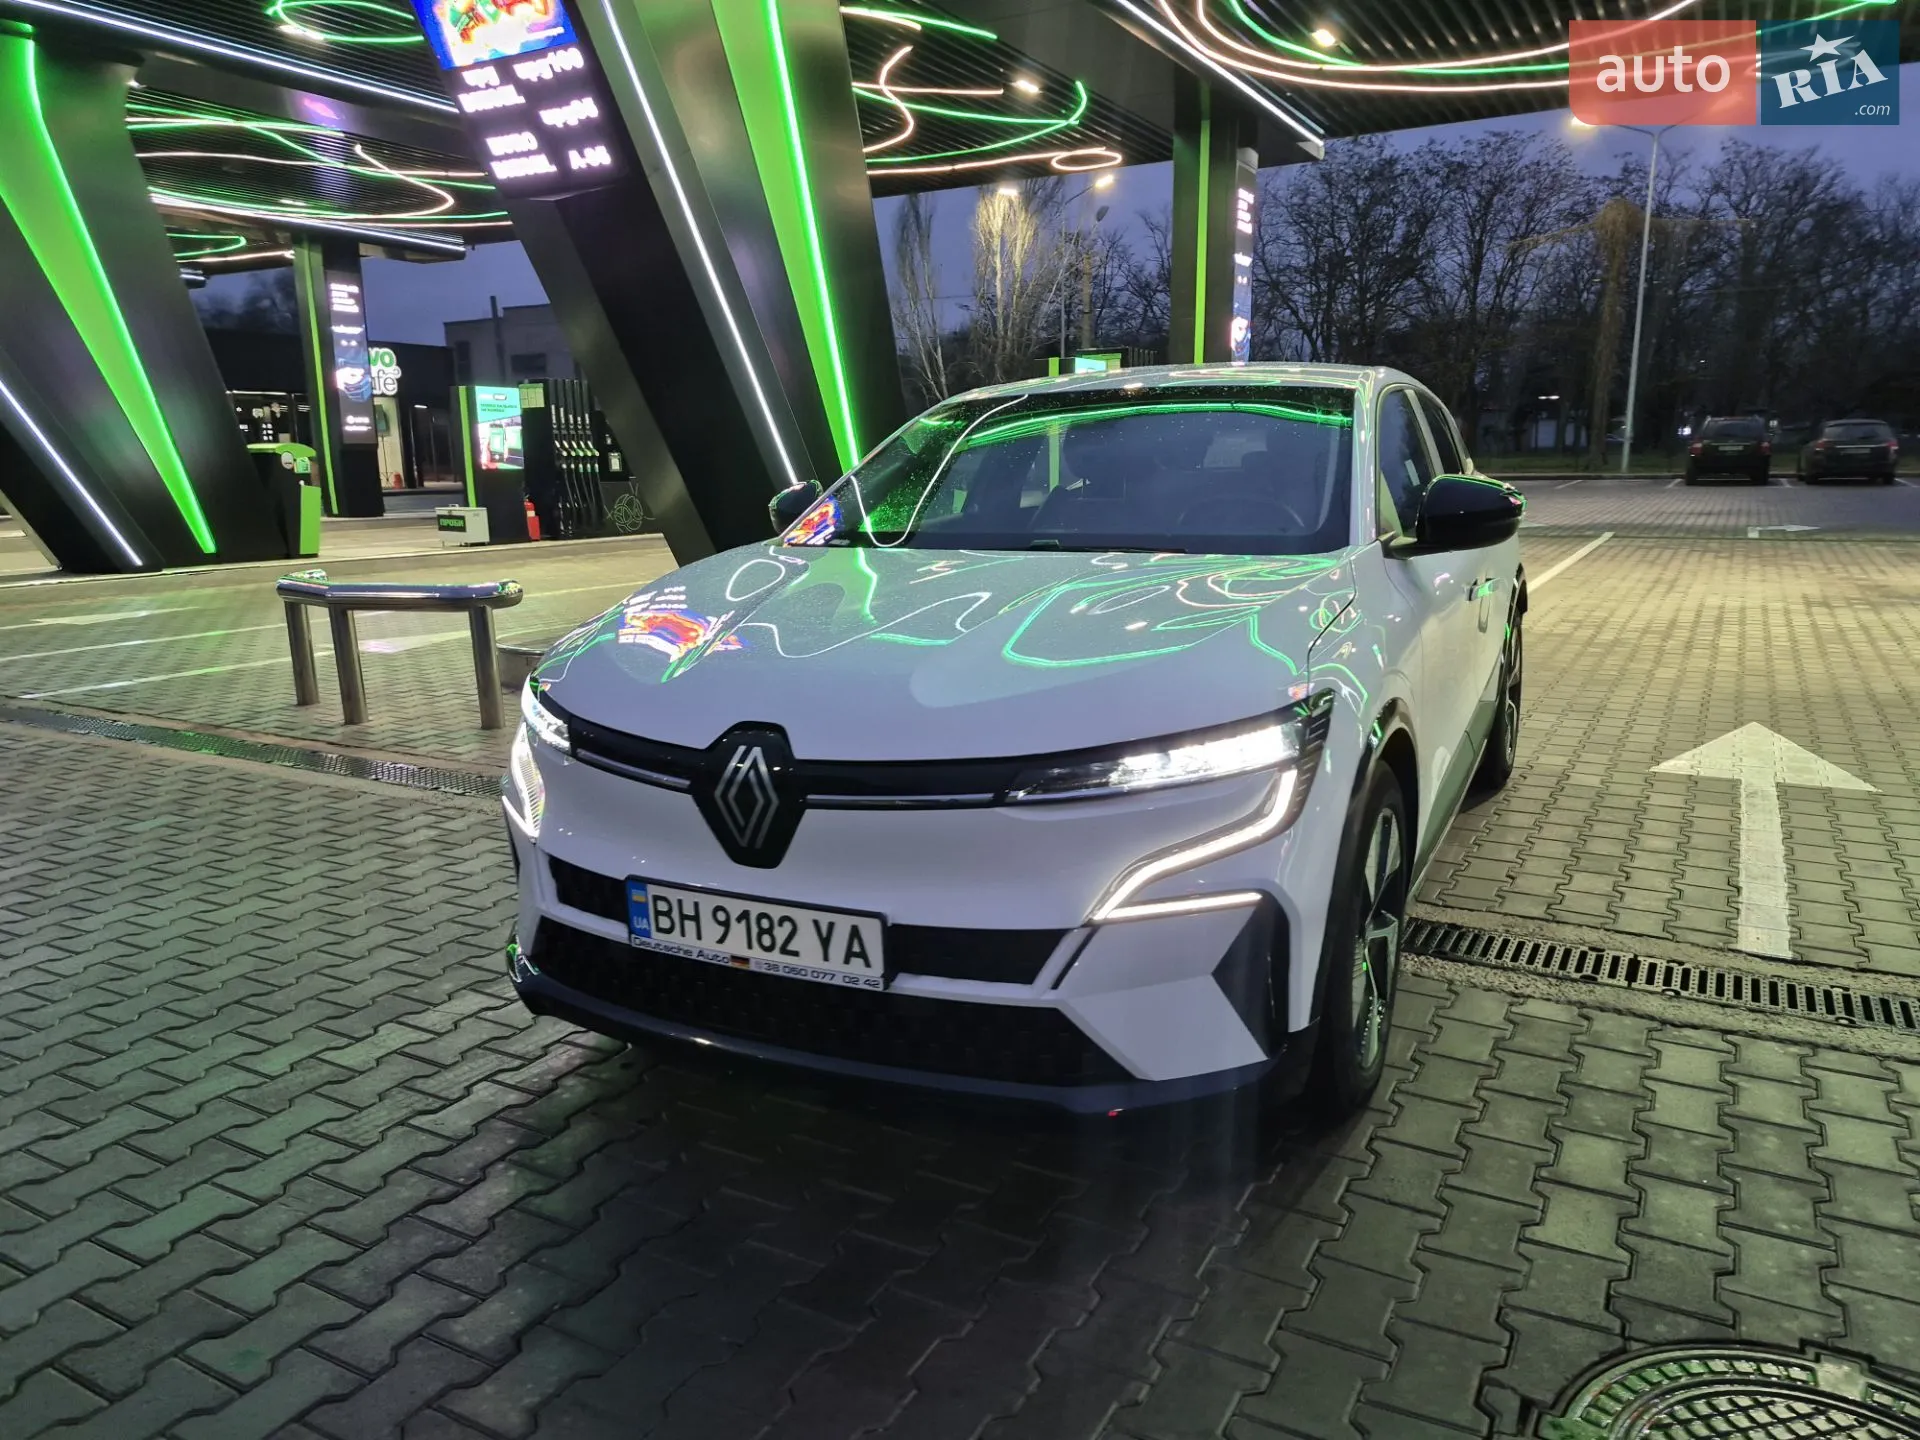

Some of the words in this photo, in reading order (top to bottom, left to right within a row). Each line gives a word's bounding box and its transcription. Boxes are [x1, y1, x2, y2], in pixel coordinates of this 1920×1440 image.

[633, 916, 649, 930] UA
[652, 894, 702, 941] BH
[711, 904, 800, 958] 9182
[812, 918, 871, 968] YA
[633, 936, 693, 957] Deutsche
[696, 949, 730, 965] Auto
[811, 969, 836, 982] 077
[843, 975, 860, 985] 02
[863, 978, 881, 989] 42
